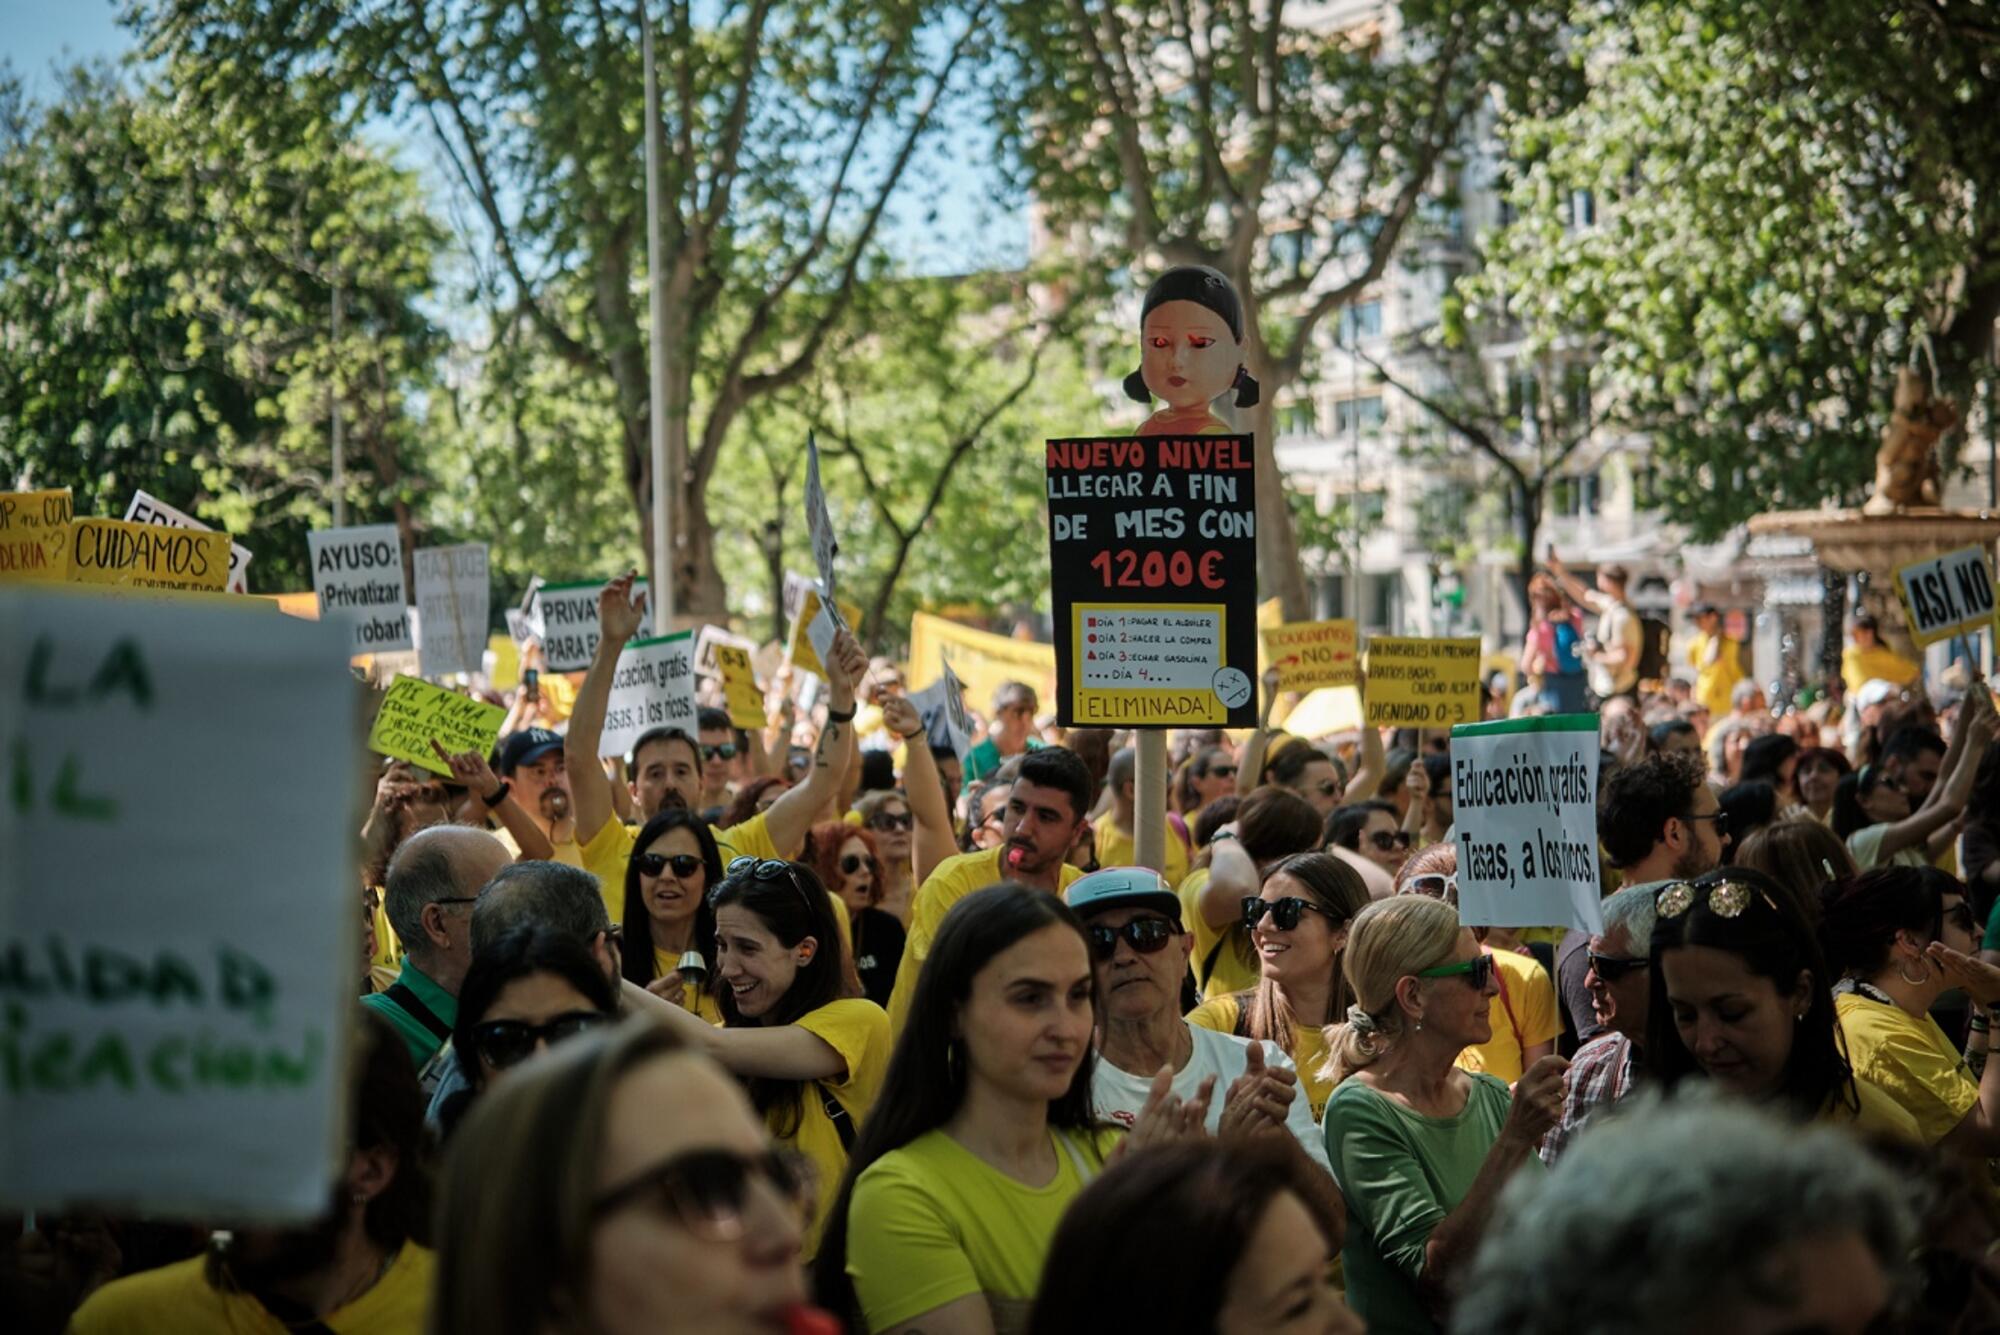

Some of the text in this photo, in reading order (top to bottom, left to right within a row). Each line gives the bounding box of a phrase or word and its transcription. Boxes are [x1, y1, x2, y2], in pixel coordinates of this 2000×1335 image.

[1047, 440, 1252, 470] NUEVO NIVEL
[1048, 472, 1237, 503] LLEGAR A FIN
[1054, 507, 1254, 541] DE MES CON
[75, 524, 210, 576] CUIDAMOS
[318, 541, 398, 573] AYUSO:
[1090, 549, 1226, 589] 1200€
[1909, 559, 1994, 630] ASÍ, NO
[356, 614, 409, 645] robar!
[1180, 636, 1212, 645] COMPRA
[547, 633, 586, 661] PARA
[1302, 648, 1332, 665] NO
[22, 632, 156, 708] LA
[658, 651, 691, 688] gratis.
[607, 693, 693, 732] asas, a los ricos.
[1078, 691, 1213, 720] ¡ELIMINADA!
[1370, 704, 1430, 721] DIGNIDAD
[1456, 751, 1592, 817] Educación, gratis.
[1461, 828, 1596, 889] Tasas, a los ricos.
